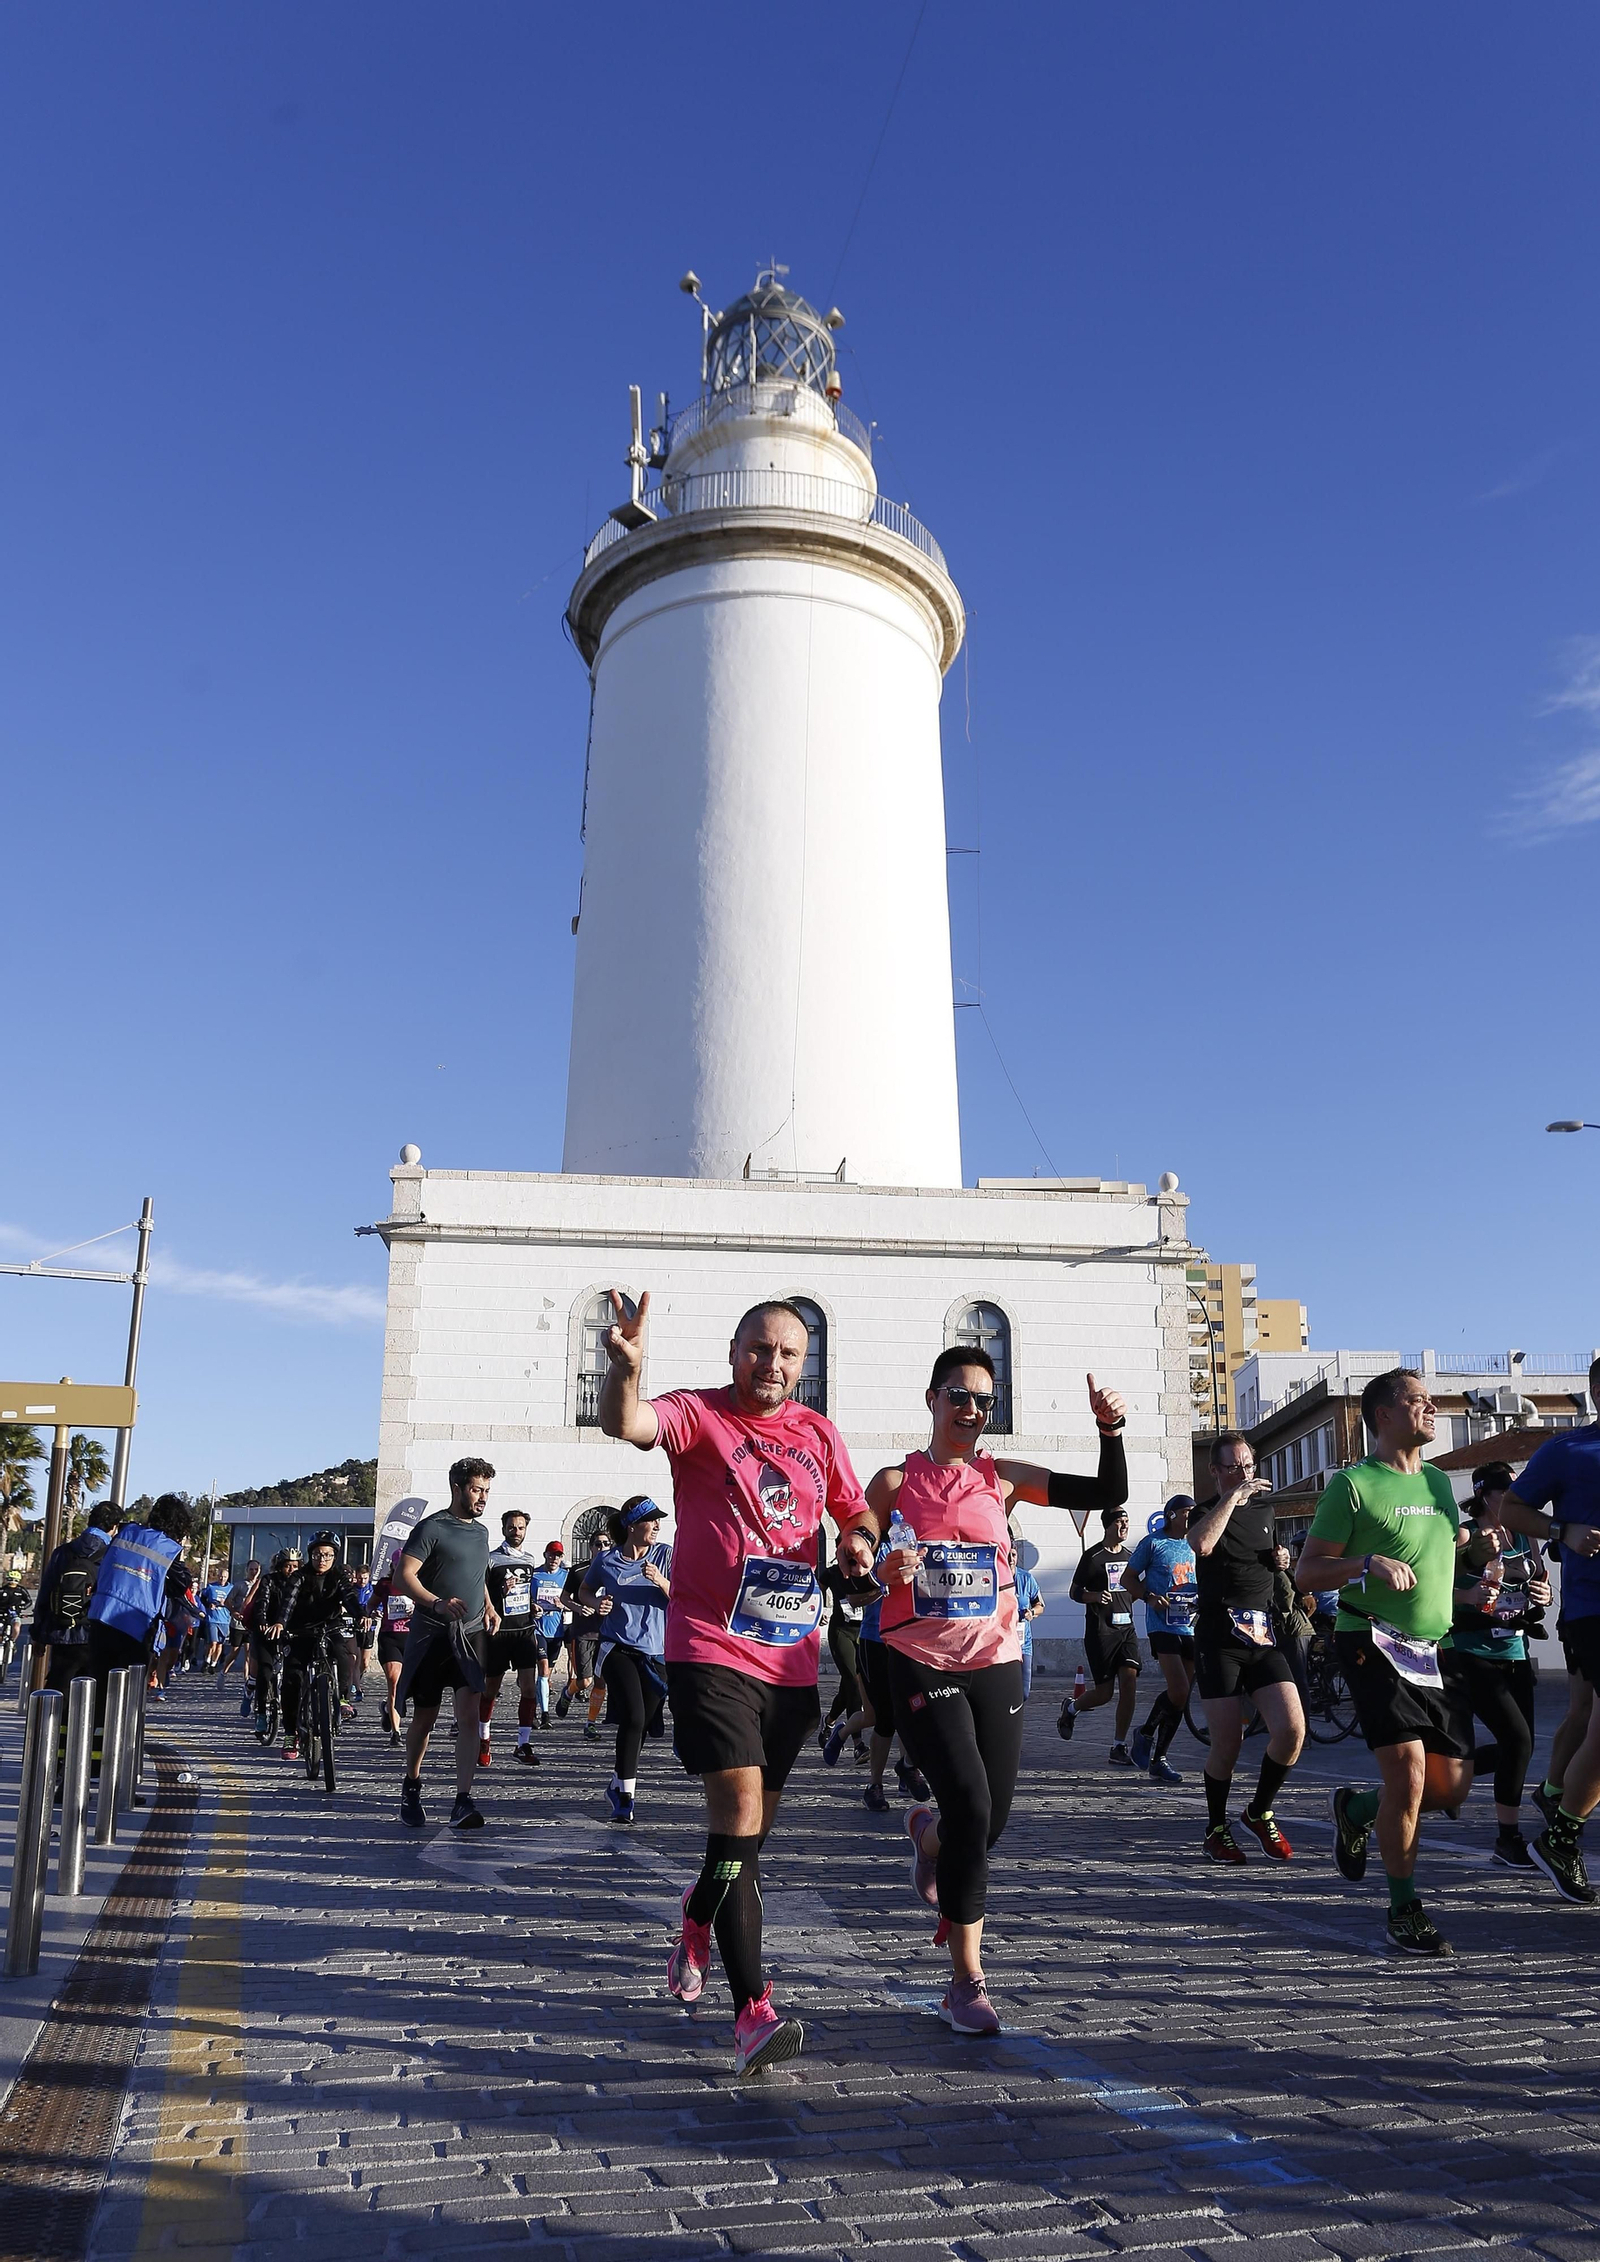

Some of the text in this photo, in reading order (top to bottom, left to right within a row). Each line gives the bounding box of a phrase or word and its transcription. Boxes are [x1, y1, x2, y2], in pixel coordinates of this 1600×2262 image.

[787, 1447, 824, 1503] RUNNING
[1395, 1505, 1437, 1517] FORMEL
[946, 1552, 978, 1560] ZURICH
[782, 1573, 812, 1584] ZURICH
[939, 1573, 973, 1587] 4070
[766, 1594, 801, 1611] 4065
[928, 1686, 960, 1699] triglav
[713, 1873, 739, 1881] cep
